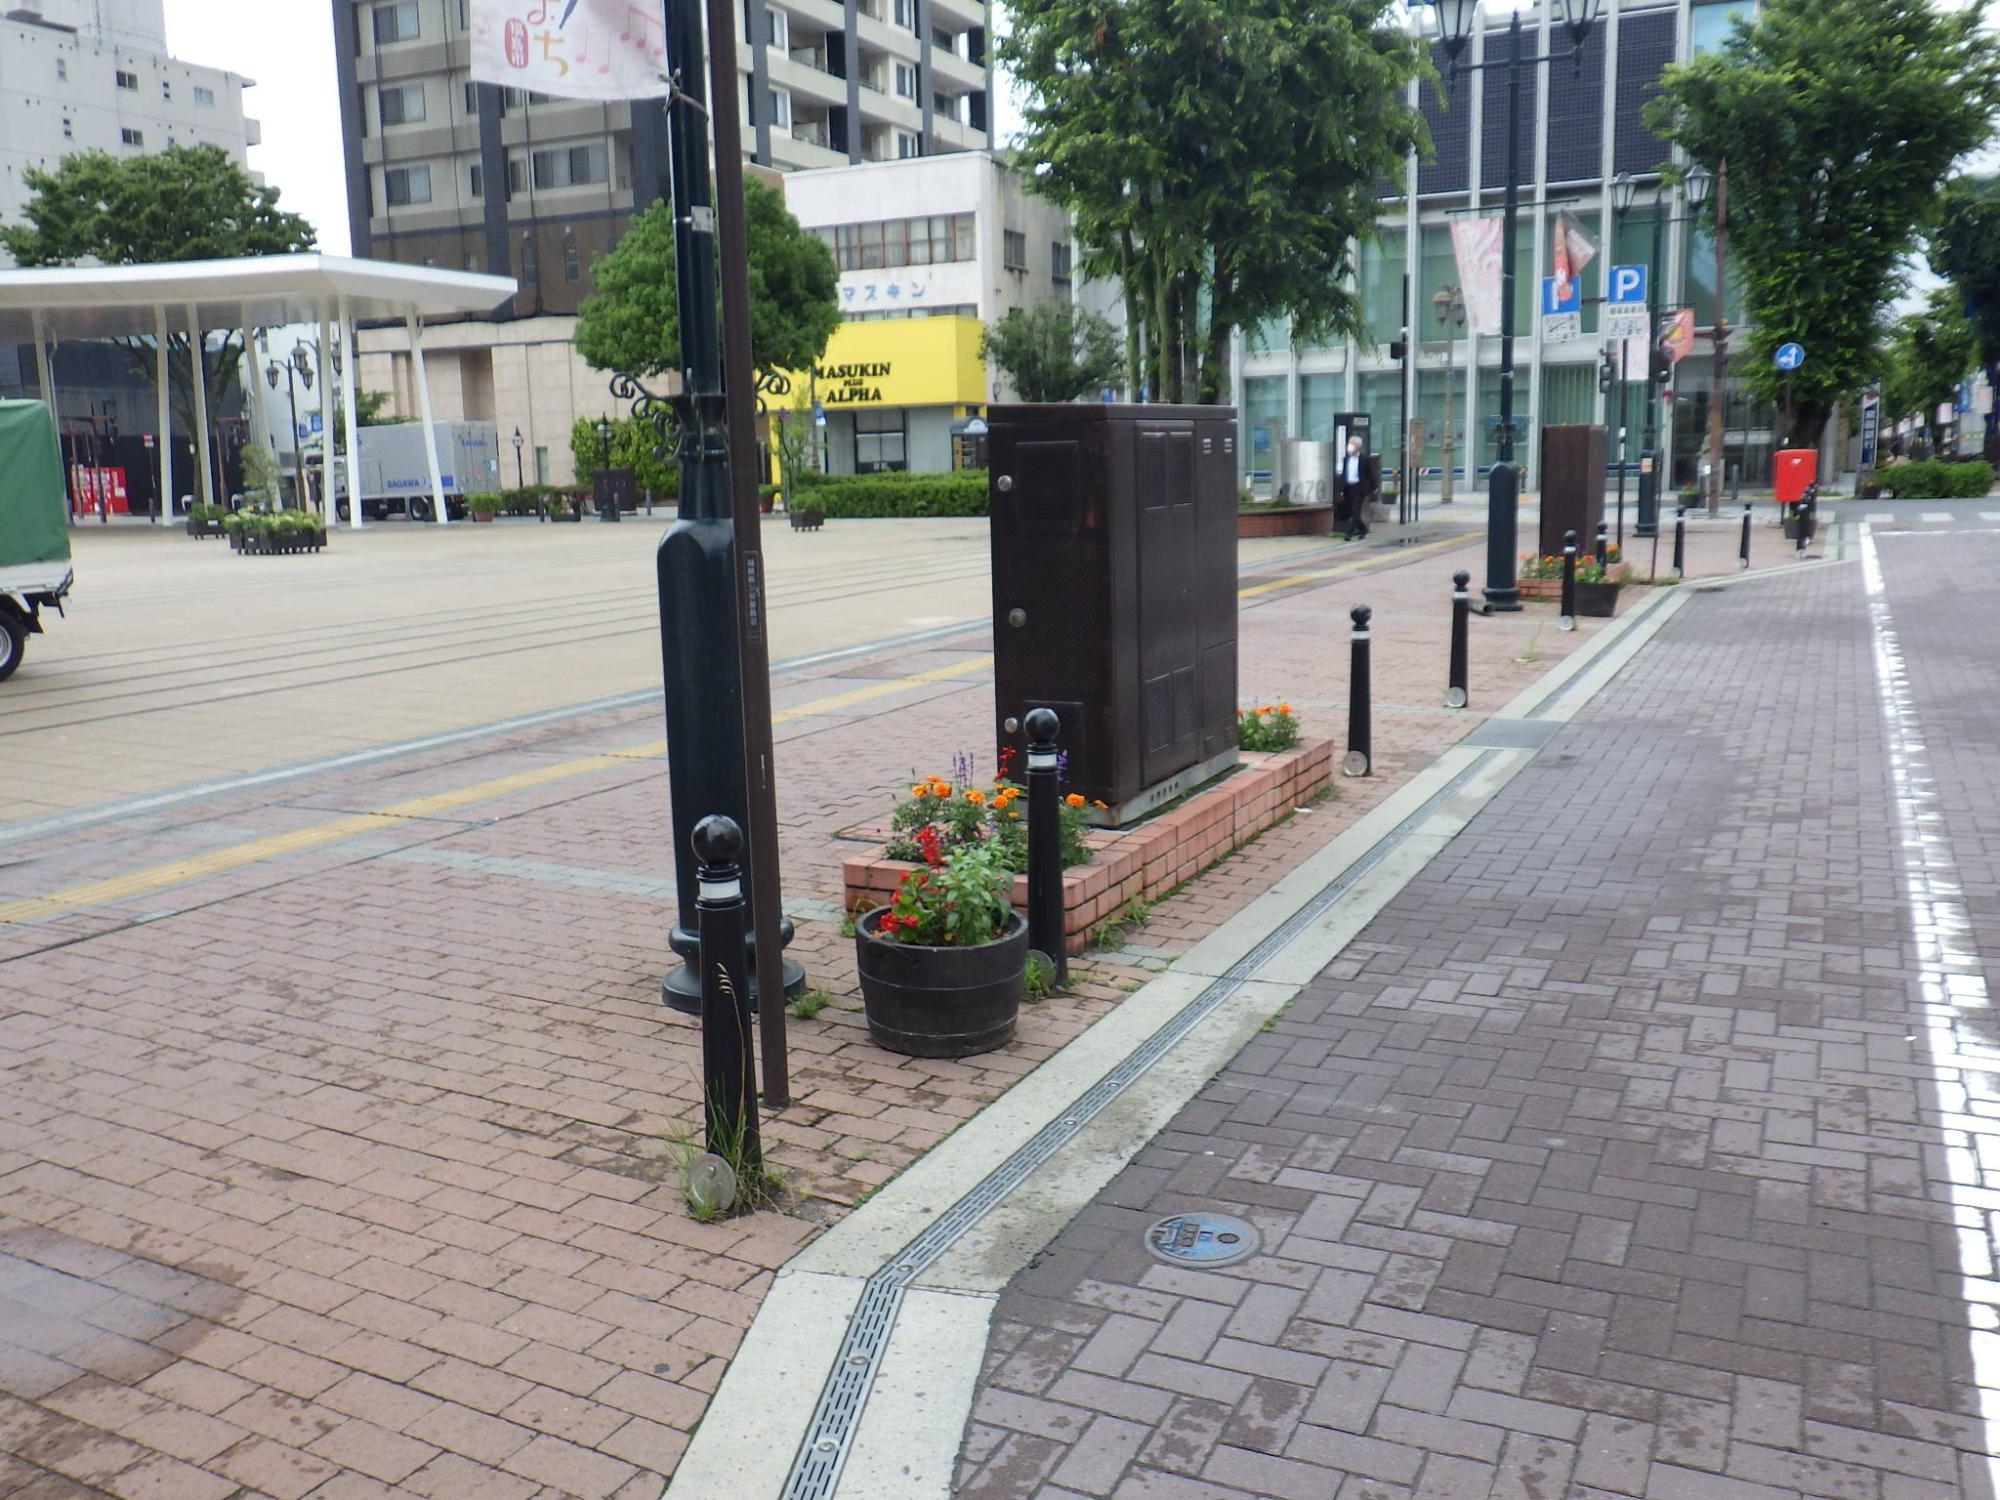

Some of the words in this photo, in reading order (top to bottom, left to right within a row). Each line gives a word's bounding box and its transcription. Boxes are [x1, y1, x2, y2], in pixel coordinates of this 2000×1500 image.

[843, 281, 926, 300] マスキン
[1617, 269, 1640, 300] P
[813, 362, 891, 380] MASUKIN
[827, 388, 882, 403] ALPHA
[387, 478, 419, 489] SAGAWA
